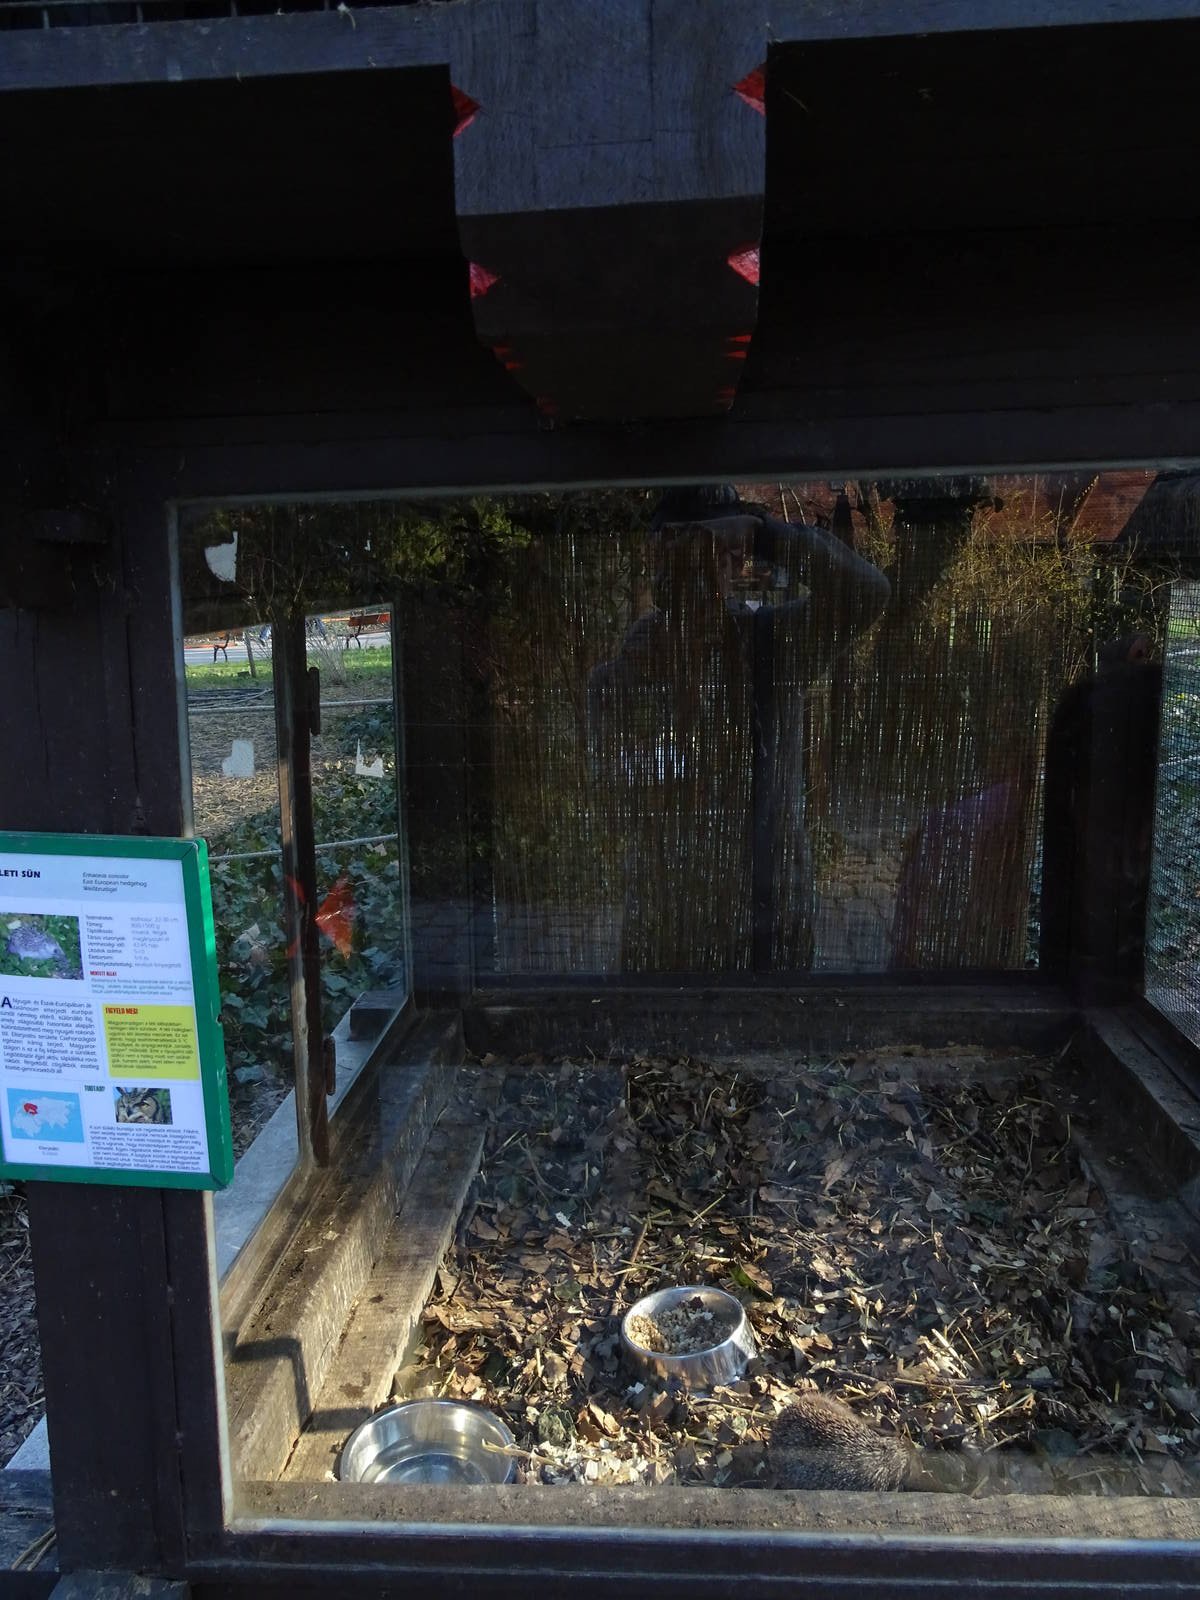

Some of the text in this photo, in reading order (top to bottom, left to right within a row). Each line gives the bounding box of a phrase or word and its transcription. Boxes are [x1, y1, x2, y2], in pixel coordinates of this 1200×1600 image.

[0, 868, 41, 878] LETI SÜN
[1, 996, 13, 1009] A
